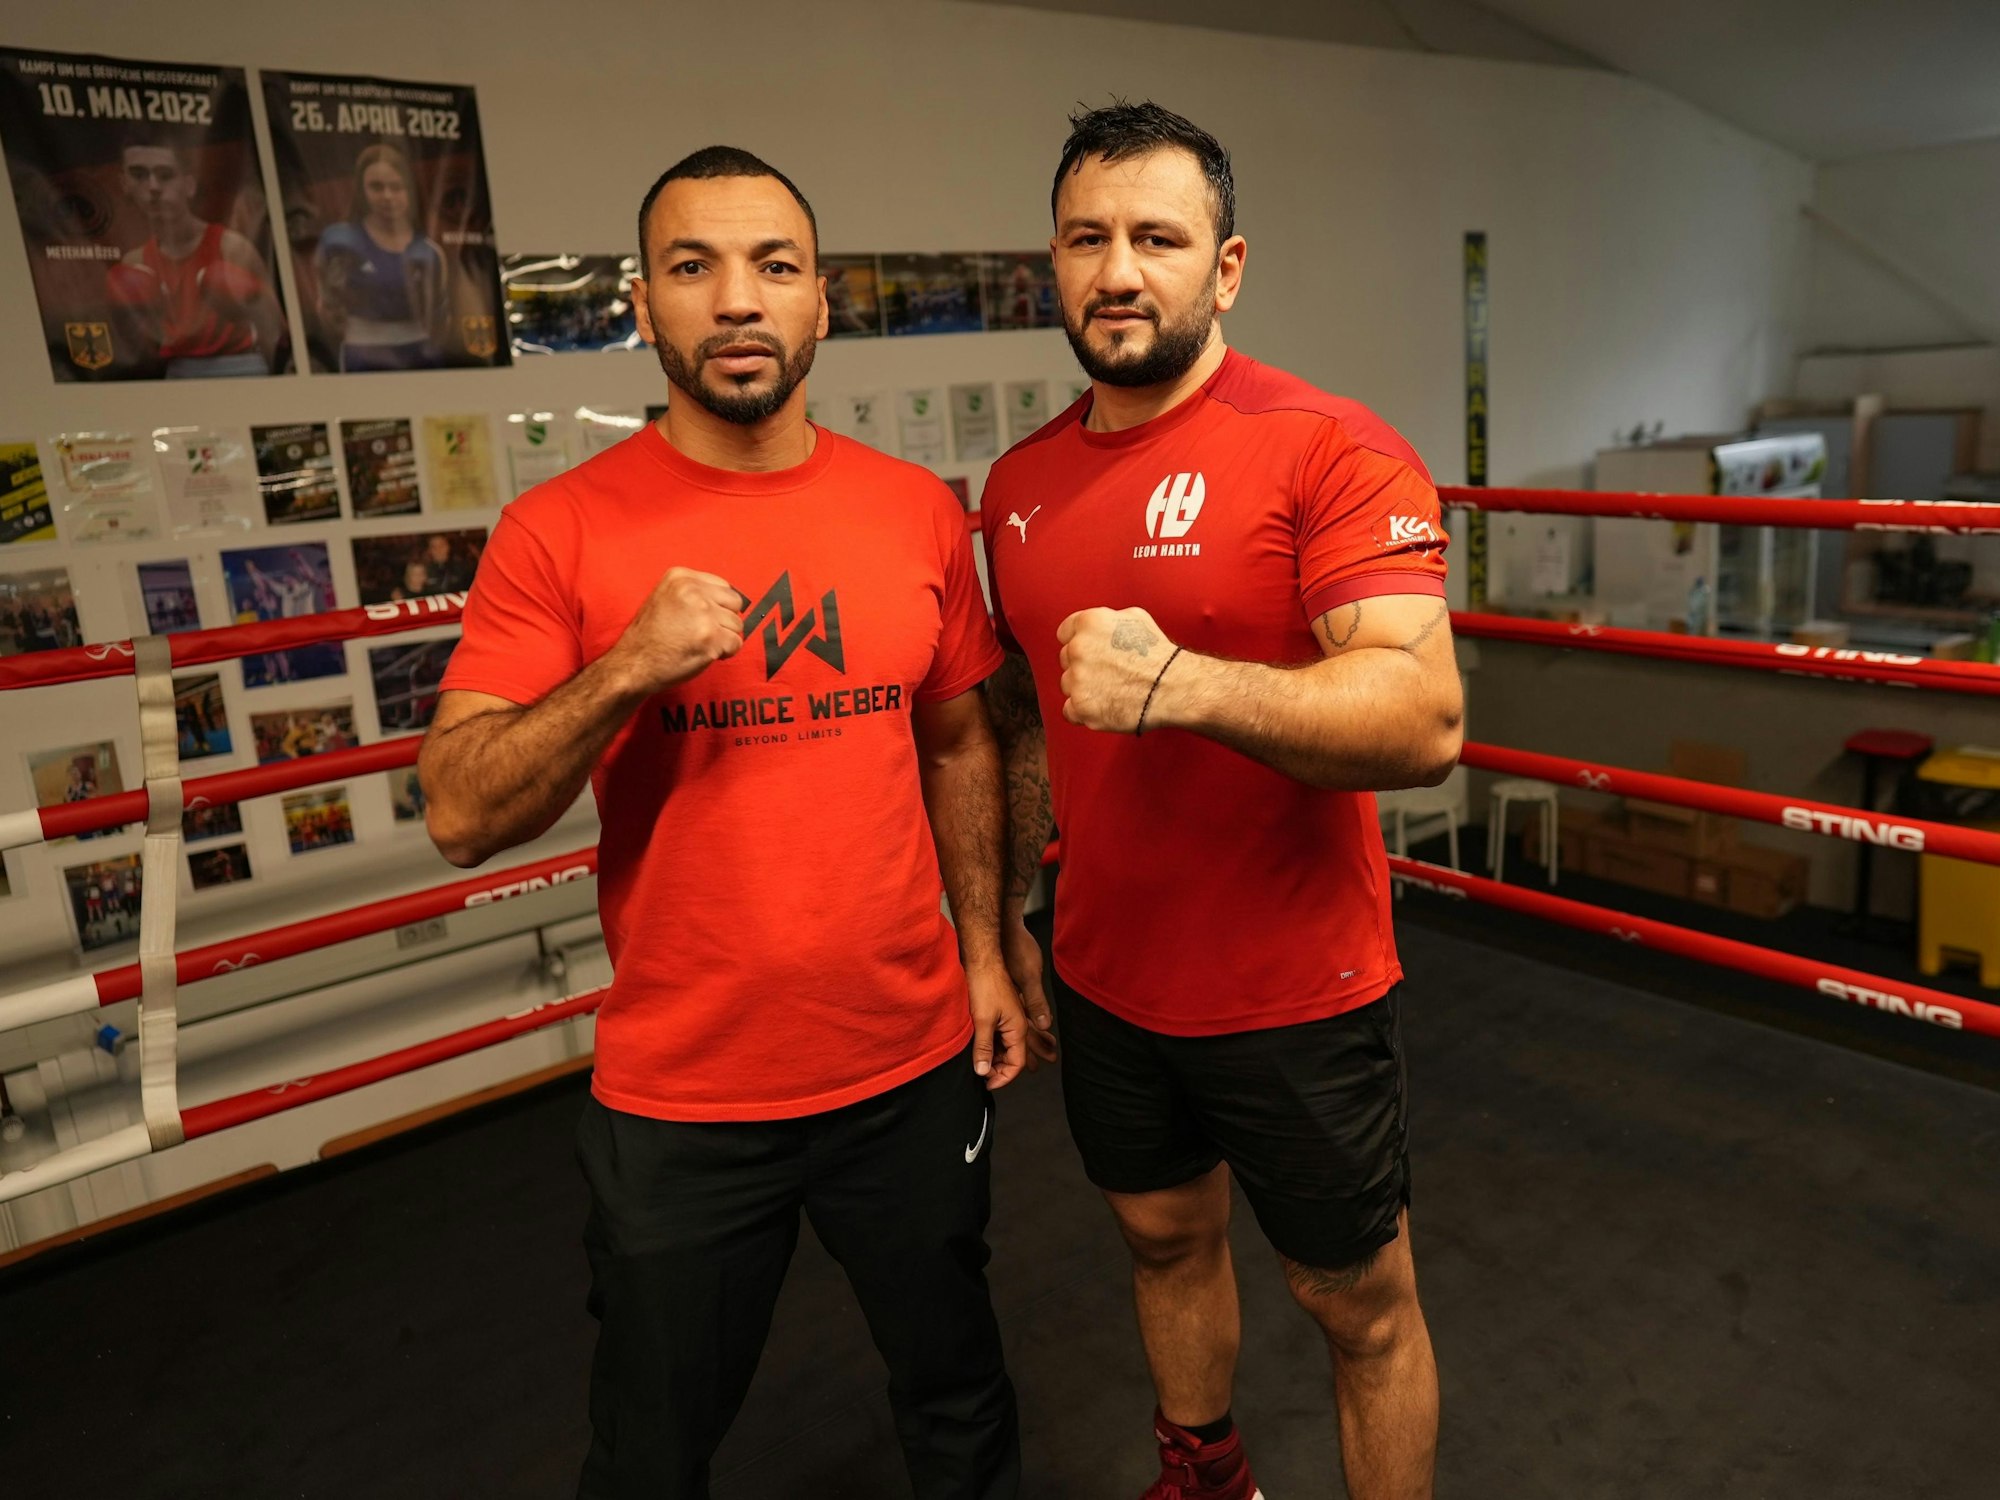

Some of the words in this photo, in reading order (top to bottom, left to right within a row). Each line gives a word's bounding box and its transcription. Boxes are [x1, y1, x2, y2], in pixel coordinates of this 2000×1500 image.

[18, 58, 56, 75] KAMPF
[38, 82, 85, 118] 10.
[86, 85, 144, 120] MAI
[145, 89, 213, 125] 2022
[290, 101, 333, 132] 26.
[338, 103, 405, 135] APRIL
[406, 108, 461, 139] 2022
[1133, 545, 1157, 558] LEON
[1160, 543, 1201, 557] HARTH
[660, 696, 794, 734] MAURICE
[807, 684, 901, 722] WEBER
[735, 734, 788, 746] BEYOND
[798, 728, 842, 741] LIMITS
[1782, 806, 1925, 852] STING
[1817, 978, 1963, 1030] STING
